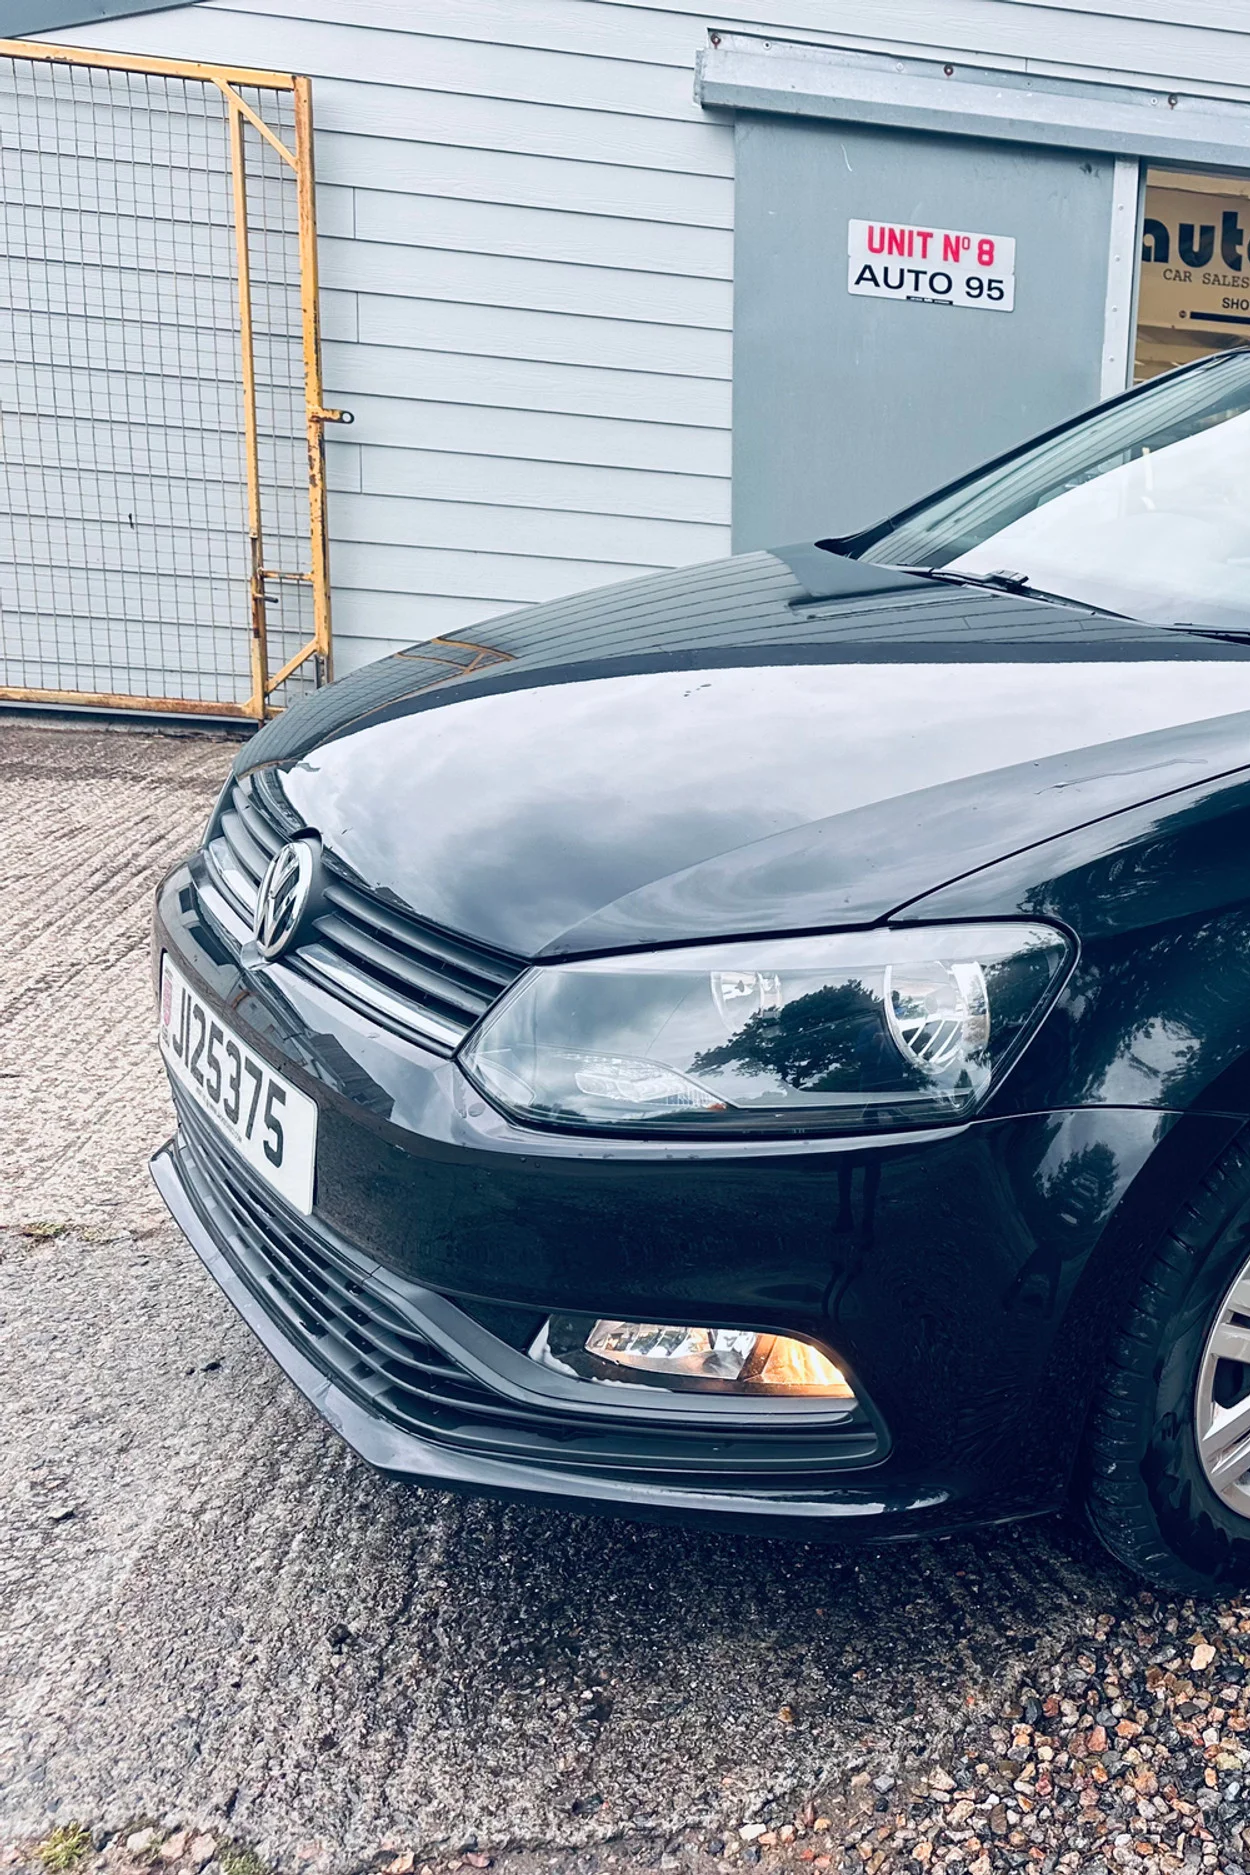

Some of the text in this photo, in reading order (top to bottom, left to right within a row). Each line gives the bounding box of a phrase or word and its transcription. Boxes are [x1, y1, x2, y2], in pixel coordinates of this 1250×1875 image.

[867, 225, 934, 259] UNIT
[977, 238, 995, 267] 8
[854, 264, 1005, 301] AUTO 95
[1162, 268, 1250, 289] CAR SALES
